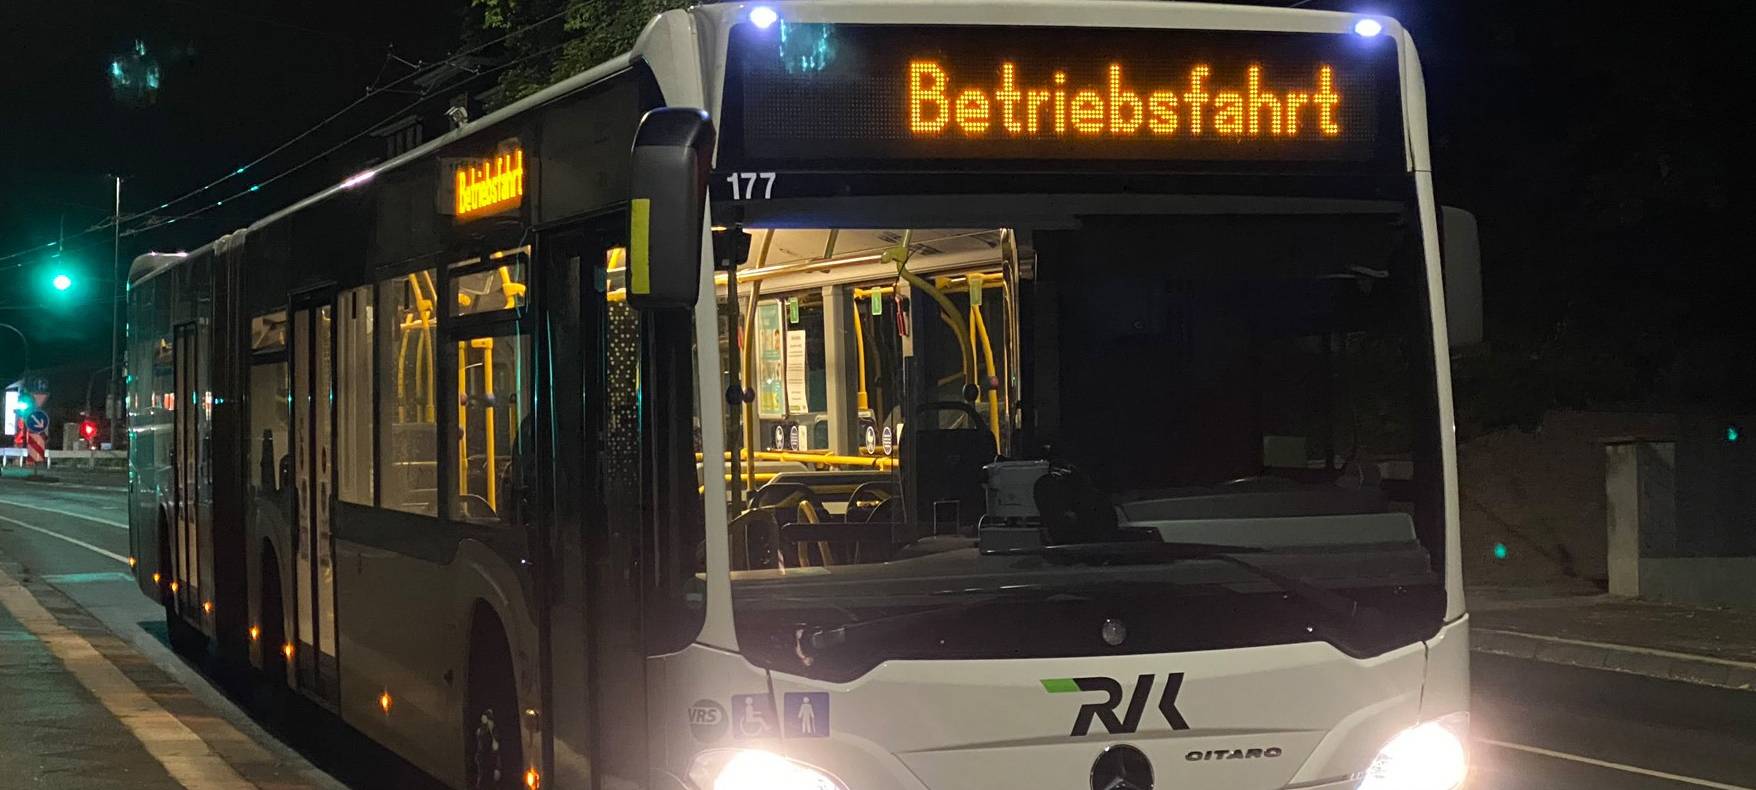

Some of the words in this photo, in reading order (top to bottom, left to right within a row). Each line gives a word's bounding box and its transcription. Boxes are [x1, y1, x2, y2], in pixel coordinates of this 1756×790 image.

[910, 61, 1341, 135] Betriebsfahrt
[458, 150, 523, 214] Betriebsfahrt
[726, 172, 776, 200] 177
[687, 707, 718, 724] VRS
[1185, 747, 1283, 762] CITARO
